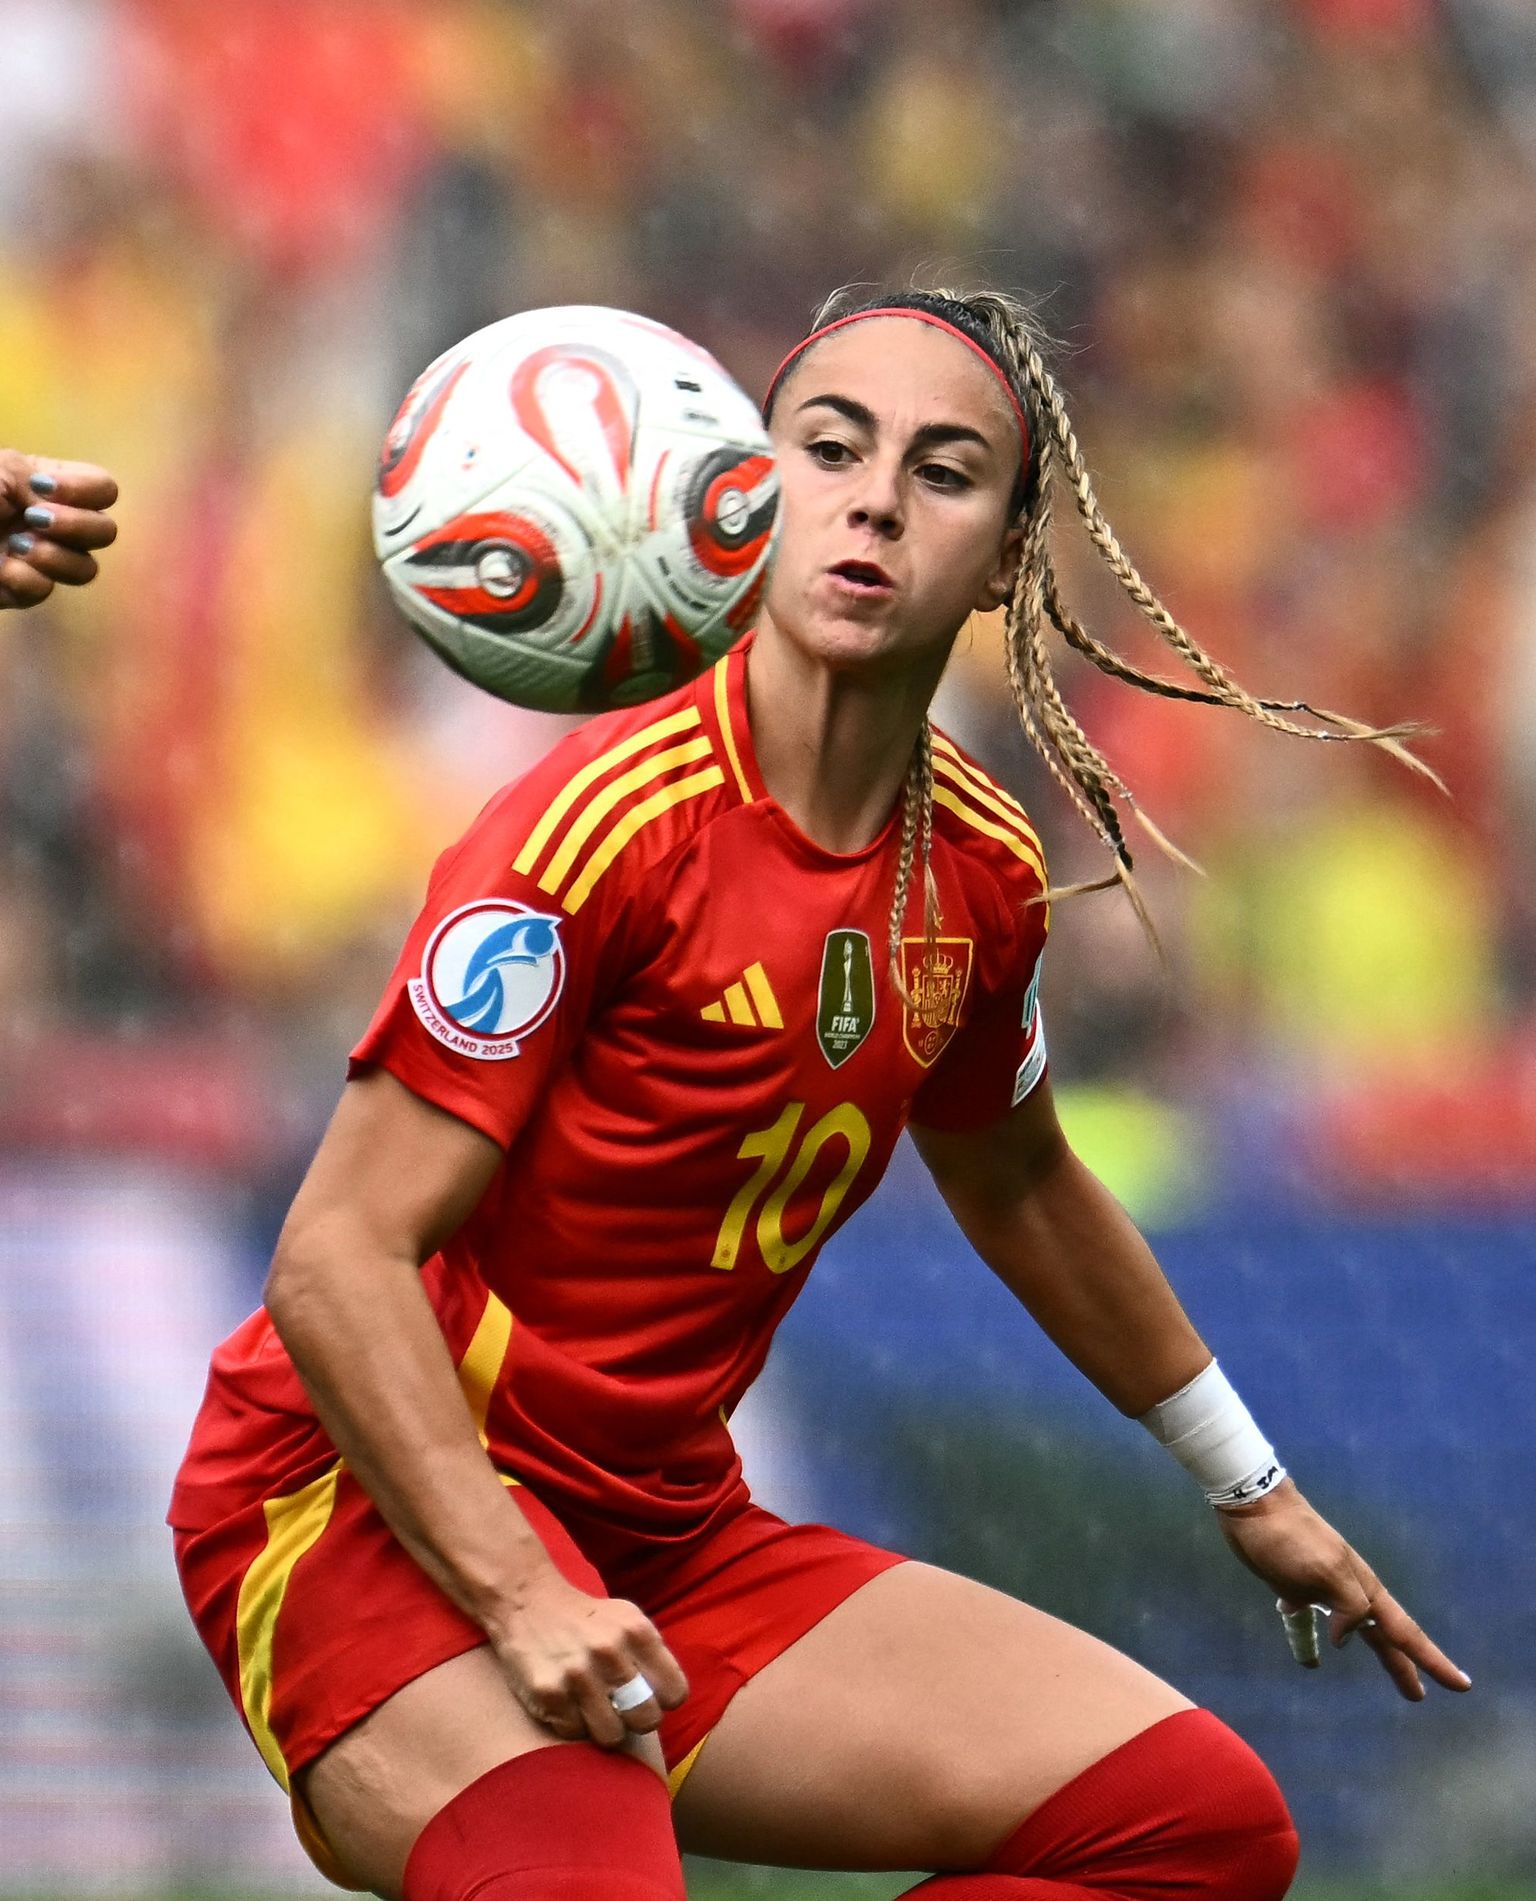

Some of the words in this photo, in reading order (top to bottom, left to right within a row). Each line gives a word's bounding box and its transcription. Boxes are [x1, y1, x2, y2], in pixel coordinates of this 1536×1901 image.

[413, 984, 478, 1053] SWITZERLAND
[481, 1042, 514, 1056] 2025
[831, 1015, 858, 1033] FIFA
[710, 1101, 872, 1275] 10
